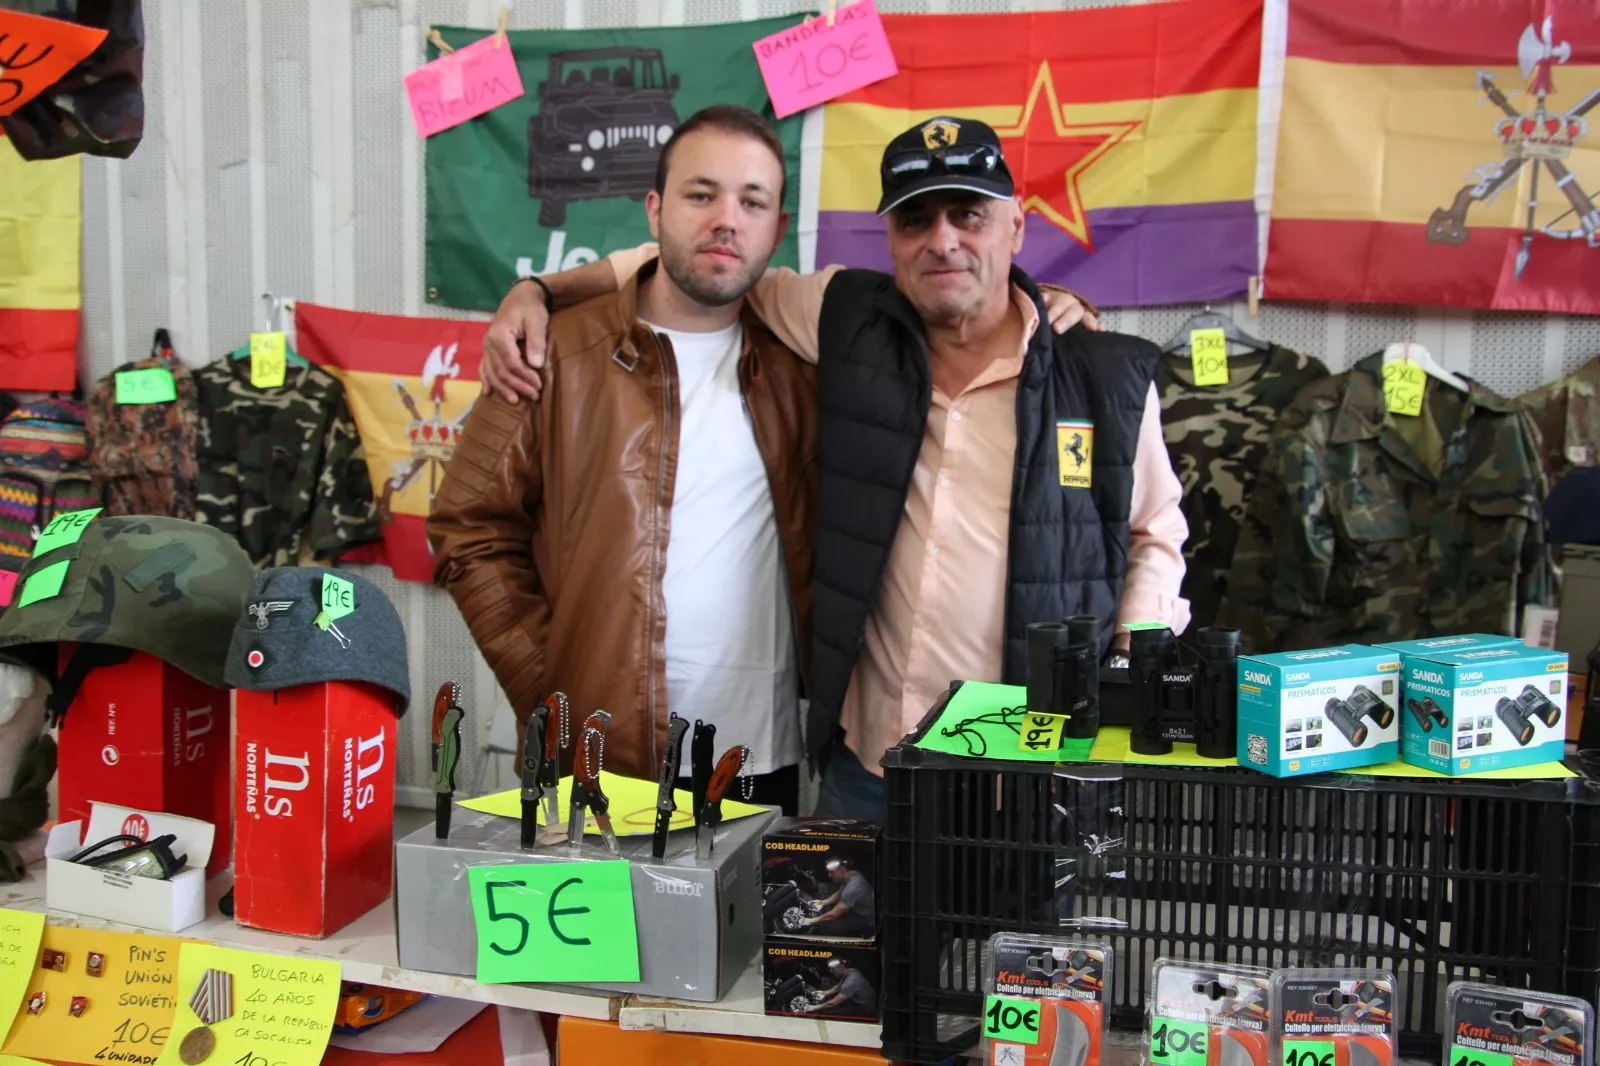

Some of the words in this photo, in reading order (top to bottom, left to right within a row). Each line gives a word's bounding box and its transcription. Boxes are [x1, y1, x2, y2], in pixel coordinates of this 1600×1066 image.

[760, 7, 867, 59] BANDEAS
[789, 32, 874, 94] 10€
[516, 231, 599, 278] Je
[43, 513, 95, 537] 19€
[324, 580, 351, 608] 19€
[1244, 670, 1271, 686] SANDA
[1286, 672, 1310, 682] SANDA
[1412, 669, 1443, 685] SANDA
[1459, 671, 1484, 681] SANDA
[1287, 686, 1337, 699] PRISMATICOS
[1407, 681, 1450, 697] PRISMATICOS
[1460, 686, 1508, 697] PRISMATICOS
[1025, 716, 1055, 750] 19€
[765, 842, 784, 850] COB
[785, 843, 830, 852] HEADLAMP
[768, 948, 787, 956] COB
[788, 949, 833, 959] HEADLAMP
[997, 971, 1026, 985] Kmt
[245, 988, 267, 1004] 40
[272, 992, 315, 1006] AÑOS
[997, 983, 1022, 994] Coltello
[1022, 985, 1034, 995] per
[242, 1010, 257, 1021] DE
[263, 1014, 276, 1023] LA
[987, 1000, 1038, 1033] 10€
[1285, 1009, 1315, 1023] Kmt
[112, 1018, 171, 1048] 10€
[235, 1028, 249, 1038] CA
[1284, 1023, 1311, 1032] Coltello
[1311, 1024, 1323, 1033] per
[1457, 1022, 1492, 1039] Kmt
[1153, 1024, 1206, 1057] 10€
[1457, 1035, 1486, 1048] Coltello
[1487, 1042, 1500, 1051] per
[94, 1047, 109, 1059] 4
